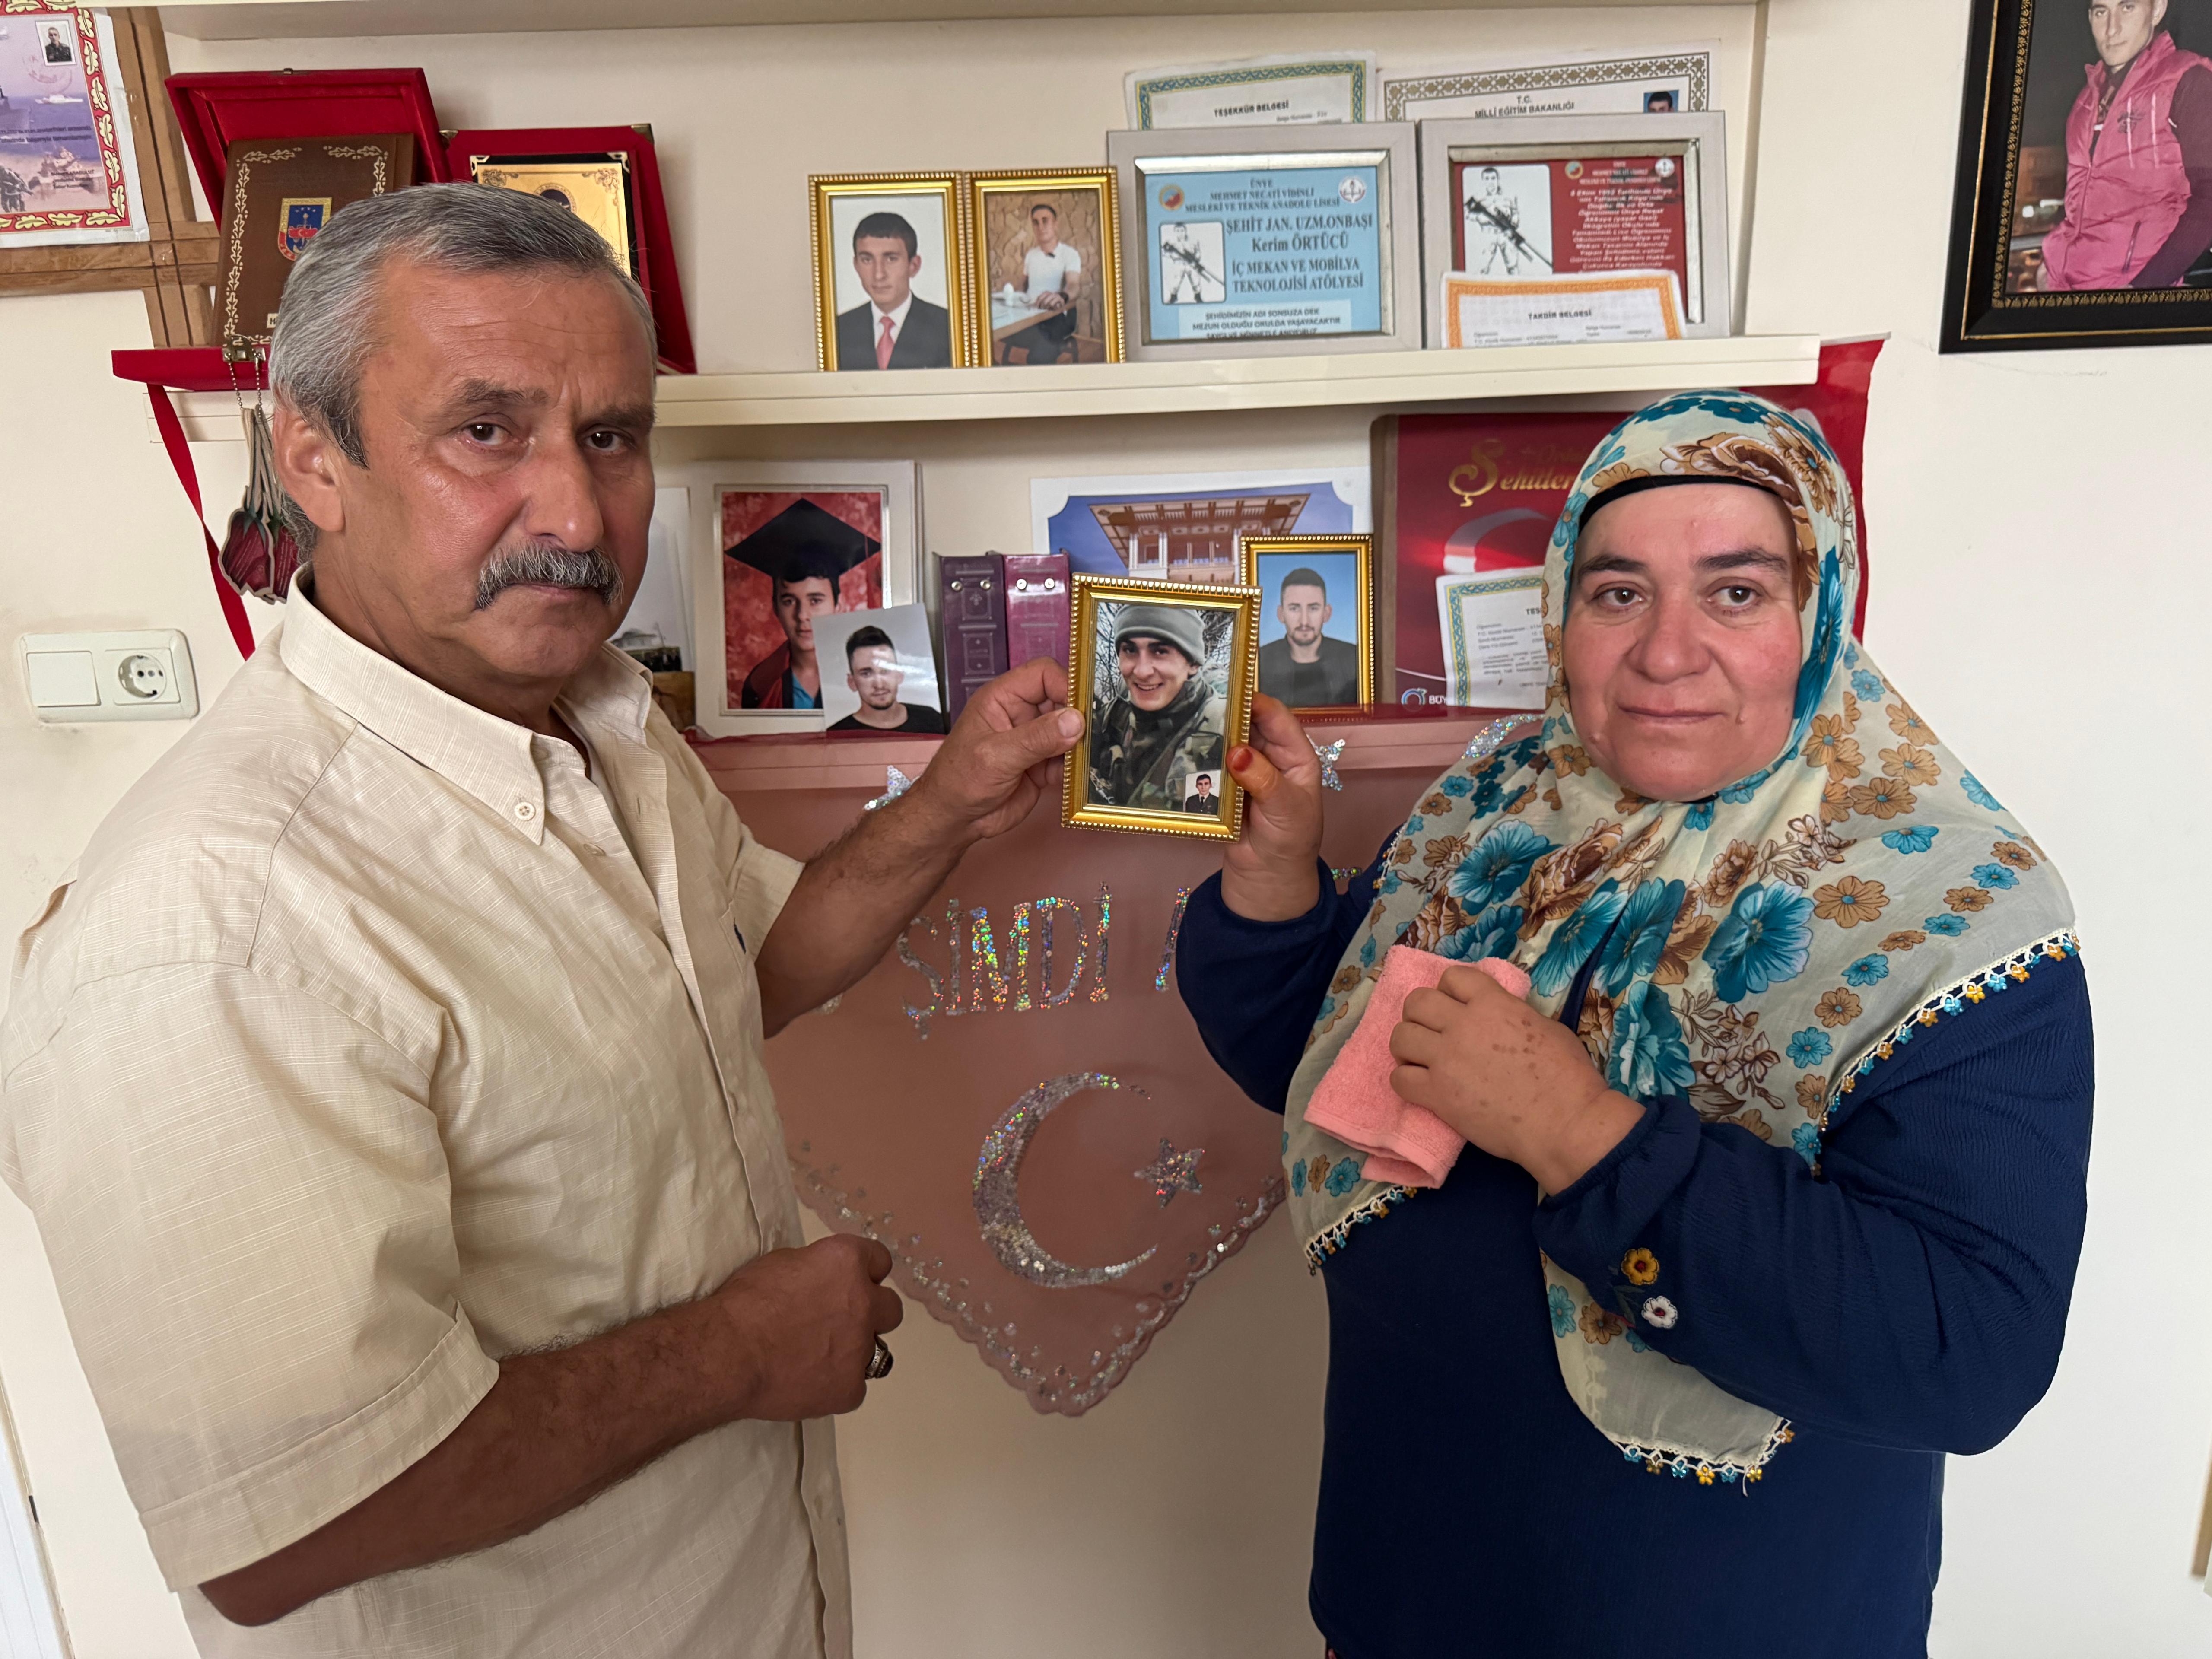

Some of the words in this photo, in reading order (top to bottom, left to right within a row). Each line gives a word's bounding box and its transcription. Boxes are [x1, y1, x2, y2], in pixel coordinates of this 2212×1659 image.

[1210, 191, 1247, 201] MEHMET
[1237, 200, 1270, 211] TEKNİK
[1271, 199, 1312, 210] ANADOLU
[1226, 216, 1264, 235] ŞEHİT
[1265, 217, 1293, 232] JAN.
[1252, 235, 1288, 253] Kerim
[1292, 231, 1349, 251] ÖRTÜCÜ
[1232, 259, 1243, 277] İÇ
[1246, 260, 1288, 275] MEKAN
[1291, 259, 1305, 273] VE
[1308, 256, 1360, 273] MOBİLYA
[1233, 274, 1307, 293] TEKNOLOJİSİ
[1309, 272, 1364, 290] ATÖLYESİ
